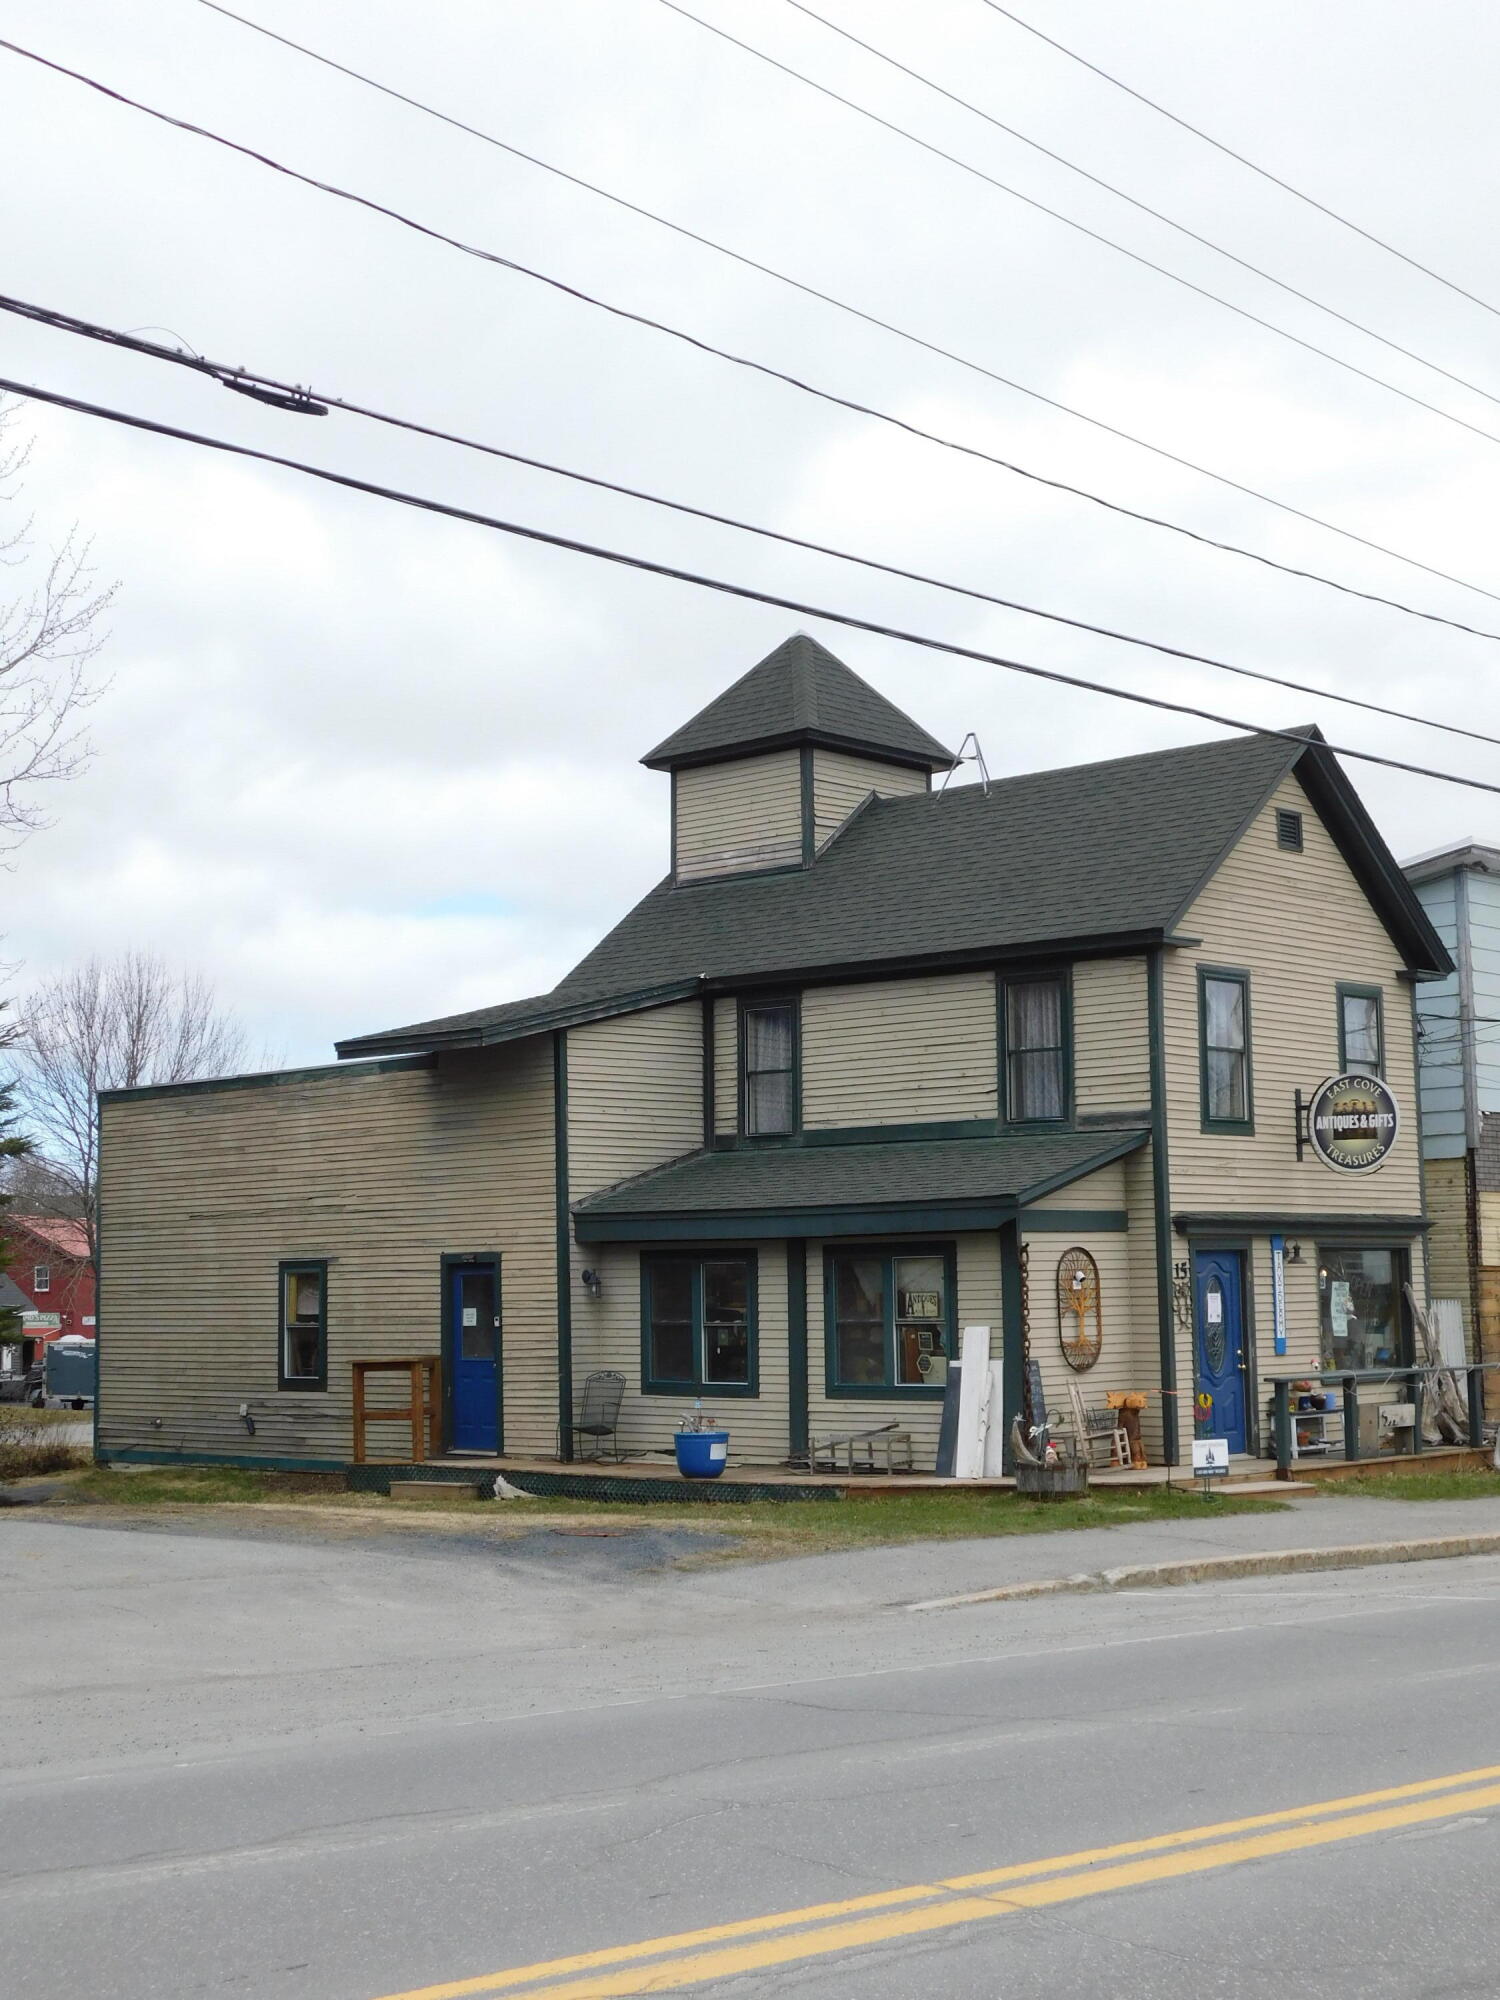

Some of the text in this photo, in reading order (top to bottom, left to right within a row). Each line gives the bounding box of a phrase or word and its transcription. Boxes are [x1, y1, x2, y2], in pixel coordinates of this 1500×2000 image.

[1326, 1078, 1383, 1099] EAST COVE
[1316, 1113, 1394, 1131] ANTIQUES & GIFTS
[1327, 1142, 1385, 1166] TREASURES
[1174, 1262, 1187, 1279] 15
